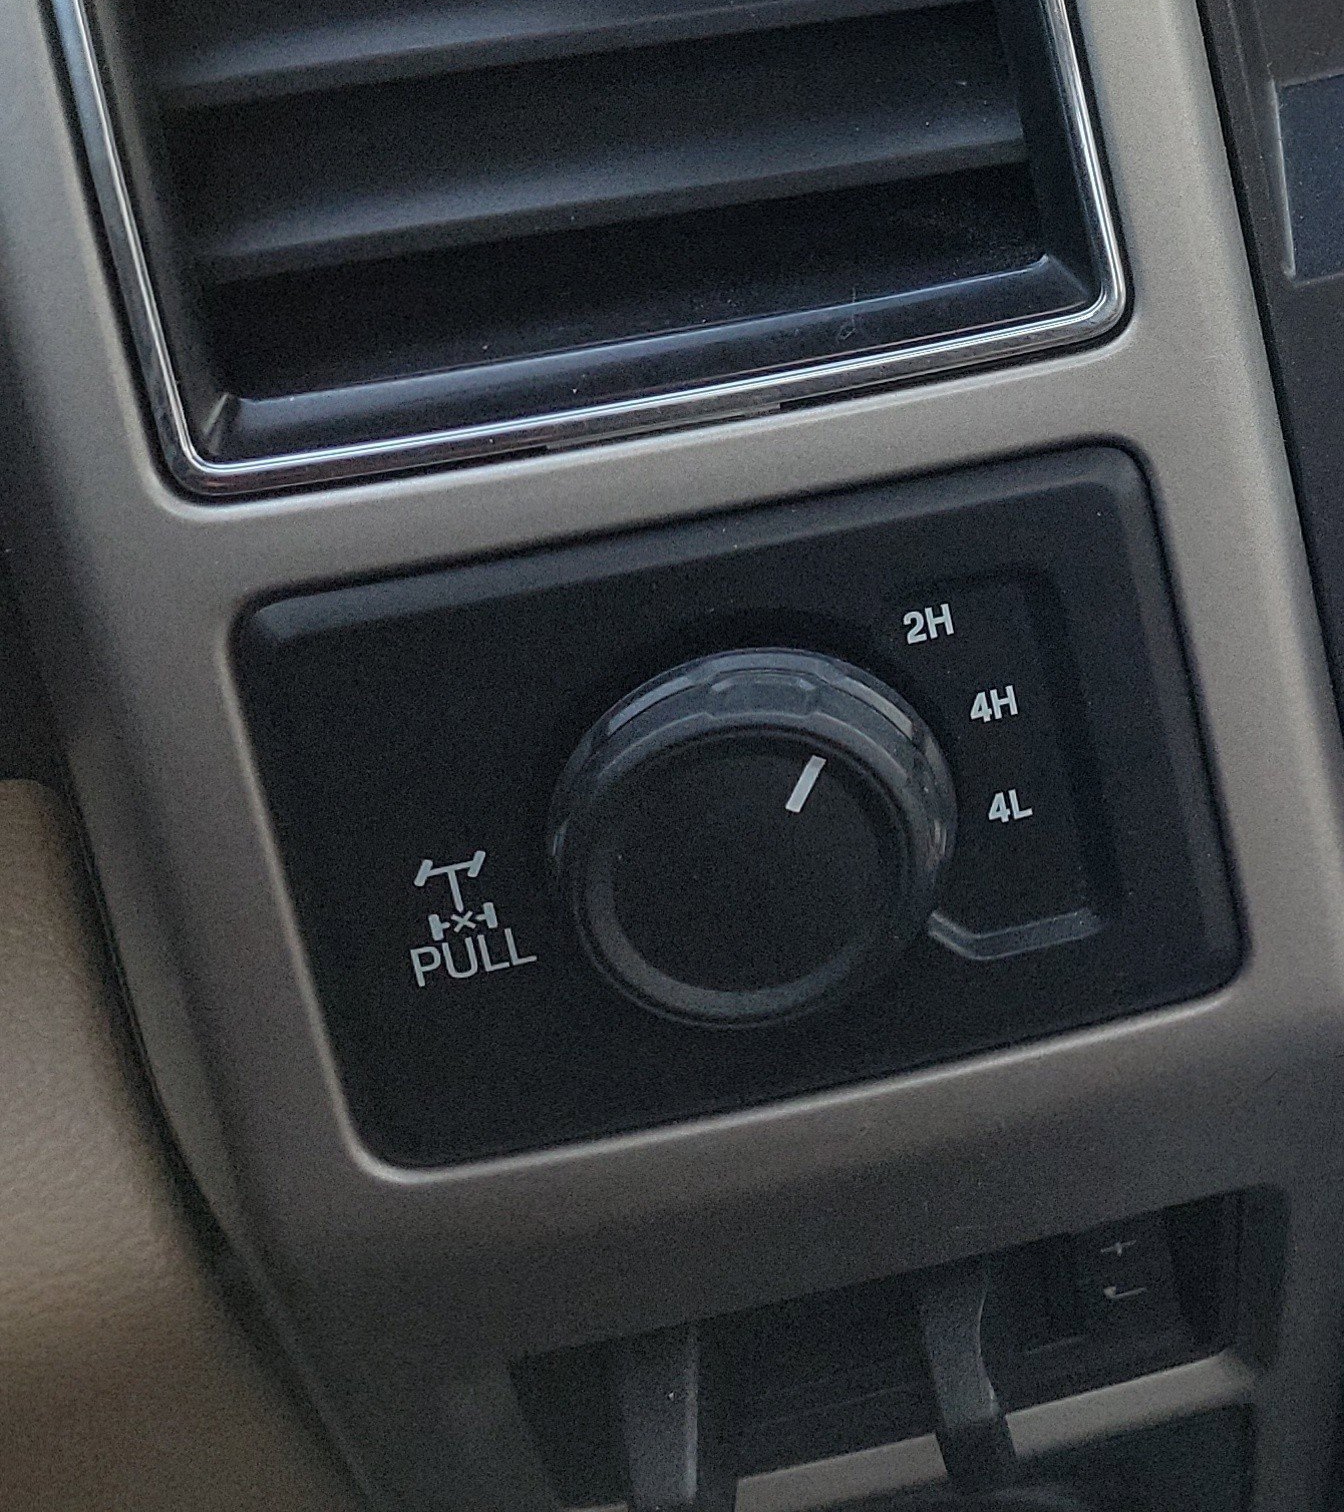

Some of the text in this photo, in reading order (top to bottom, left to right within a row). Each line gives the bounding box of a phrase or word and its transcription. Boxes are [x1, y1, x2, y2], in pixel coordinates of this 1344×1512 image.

[903, 603, 956, 644] 2H
[969, 685, 1019, 724] 4H
[987, 790, 1033, 823] 4L
[410, 929, 538, 988] PULL
